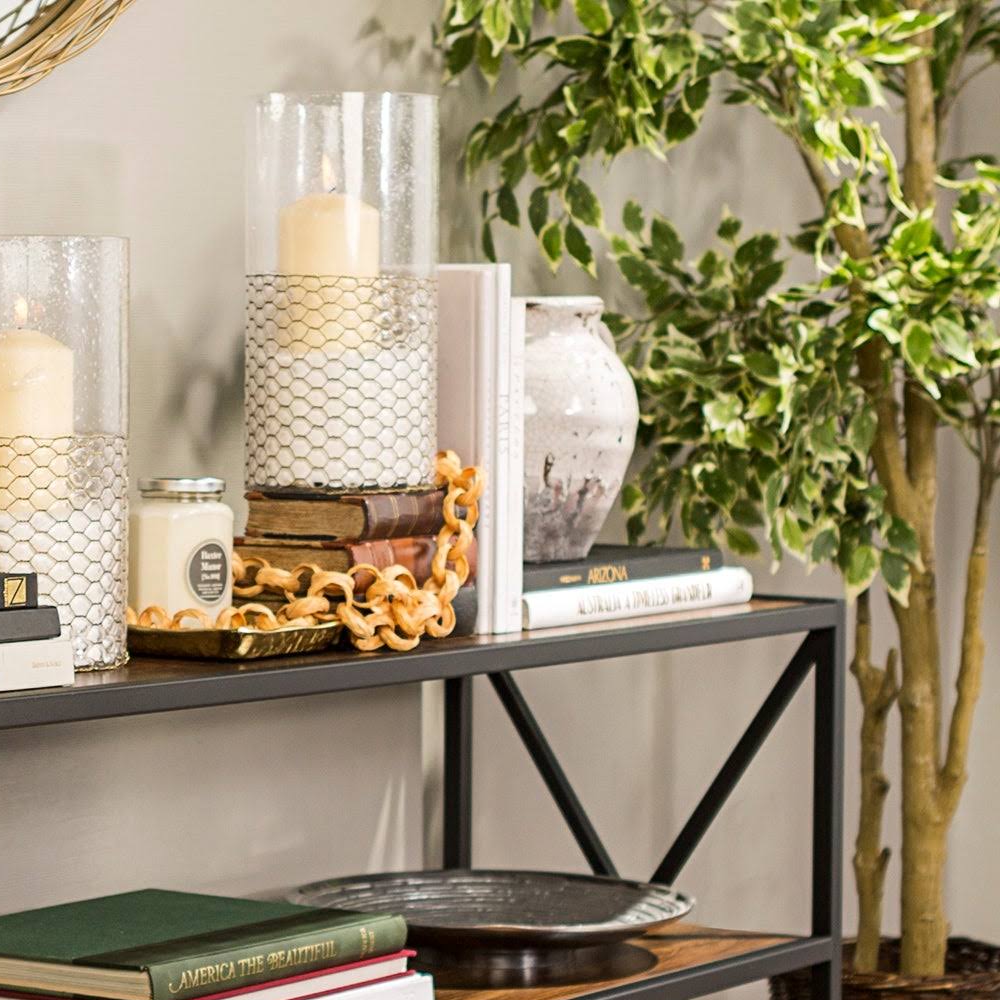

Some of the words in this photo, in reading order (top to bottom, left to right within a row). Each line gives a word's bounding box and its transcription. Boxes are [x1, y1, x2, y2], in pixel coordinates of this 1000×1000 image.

[588, 565, 628, 584] ARIZONA
[168, 962, 236, 994] AMERICA
[238, 955, 265, 977] THE
[267, 940, 337, 970] BEAUTIFUL
